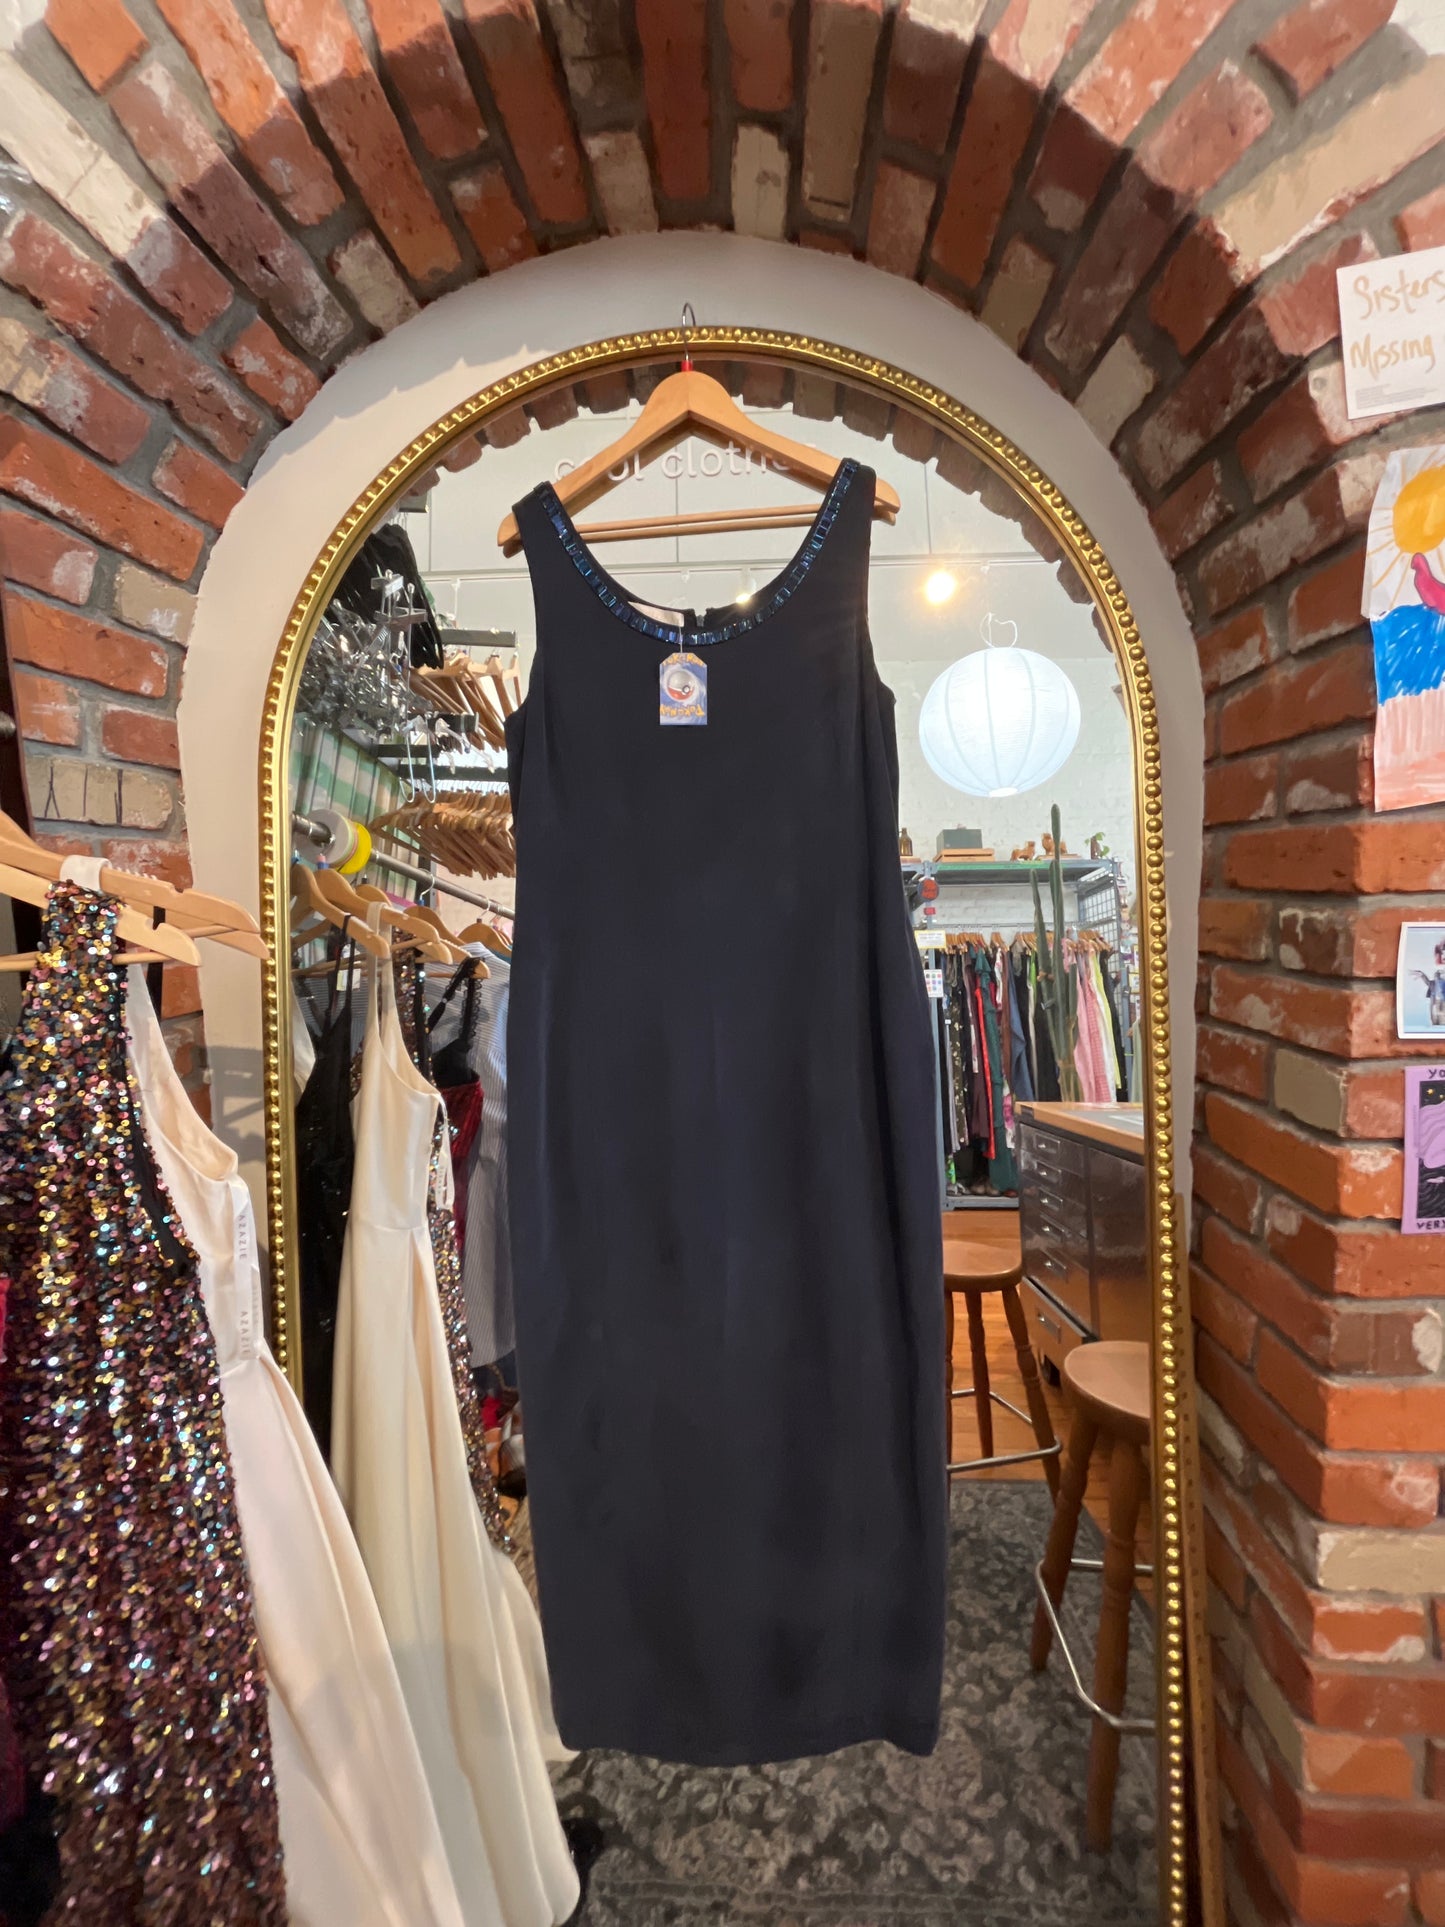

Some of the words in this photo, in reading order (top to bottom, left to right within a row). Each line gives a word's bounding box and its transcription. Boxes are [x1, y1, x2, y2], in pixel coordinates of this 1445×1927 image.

[554, 449, 644, 482] col
[661, 436, 816, 479] cloth
[238, 1214, 248, 1260] AZAZIE
